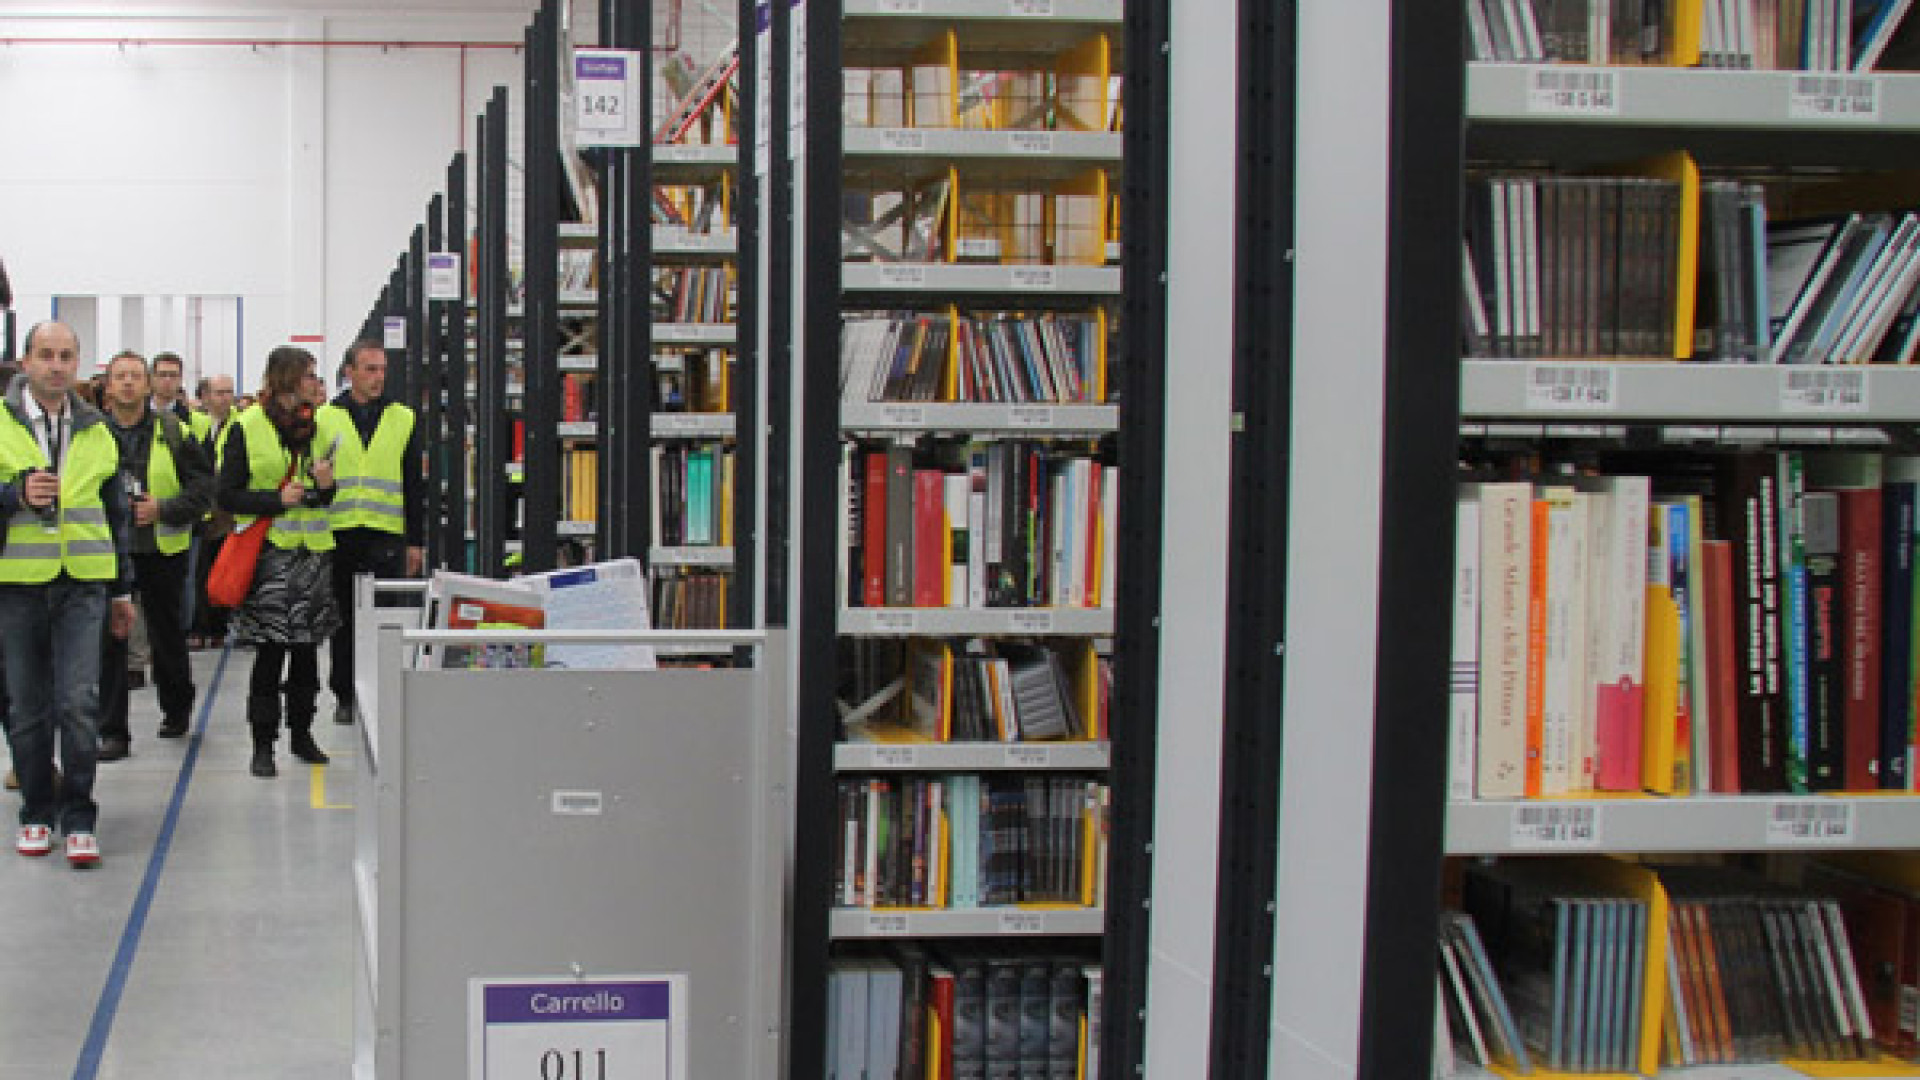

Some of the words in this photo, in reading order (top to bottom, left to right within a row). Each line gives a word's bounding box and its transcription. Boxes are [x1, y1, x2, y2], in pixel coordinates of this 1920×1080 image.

[583, 95, 621, 115] 142
[1502, 565, 1518, 619] Atlante
[1501, 627, 1518, 665] della
[1500, 670, 1518, 726] Pittura
[530, 991, 624, 1014] Carrello
[540, 1048, 607, 1080] 011
